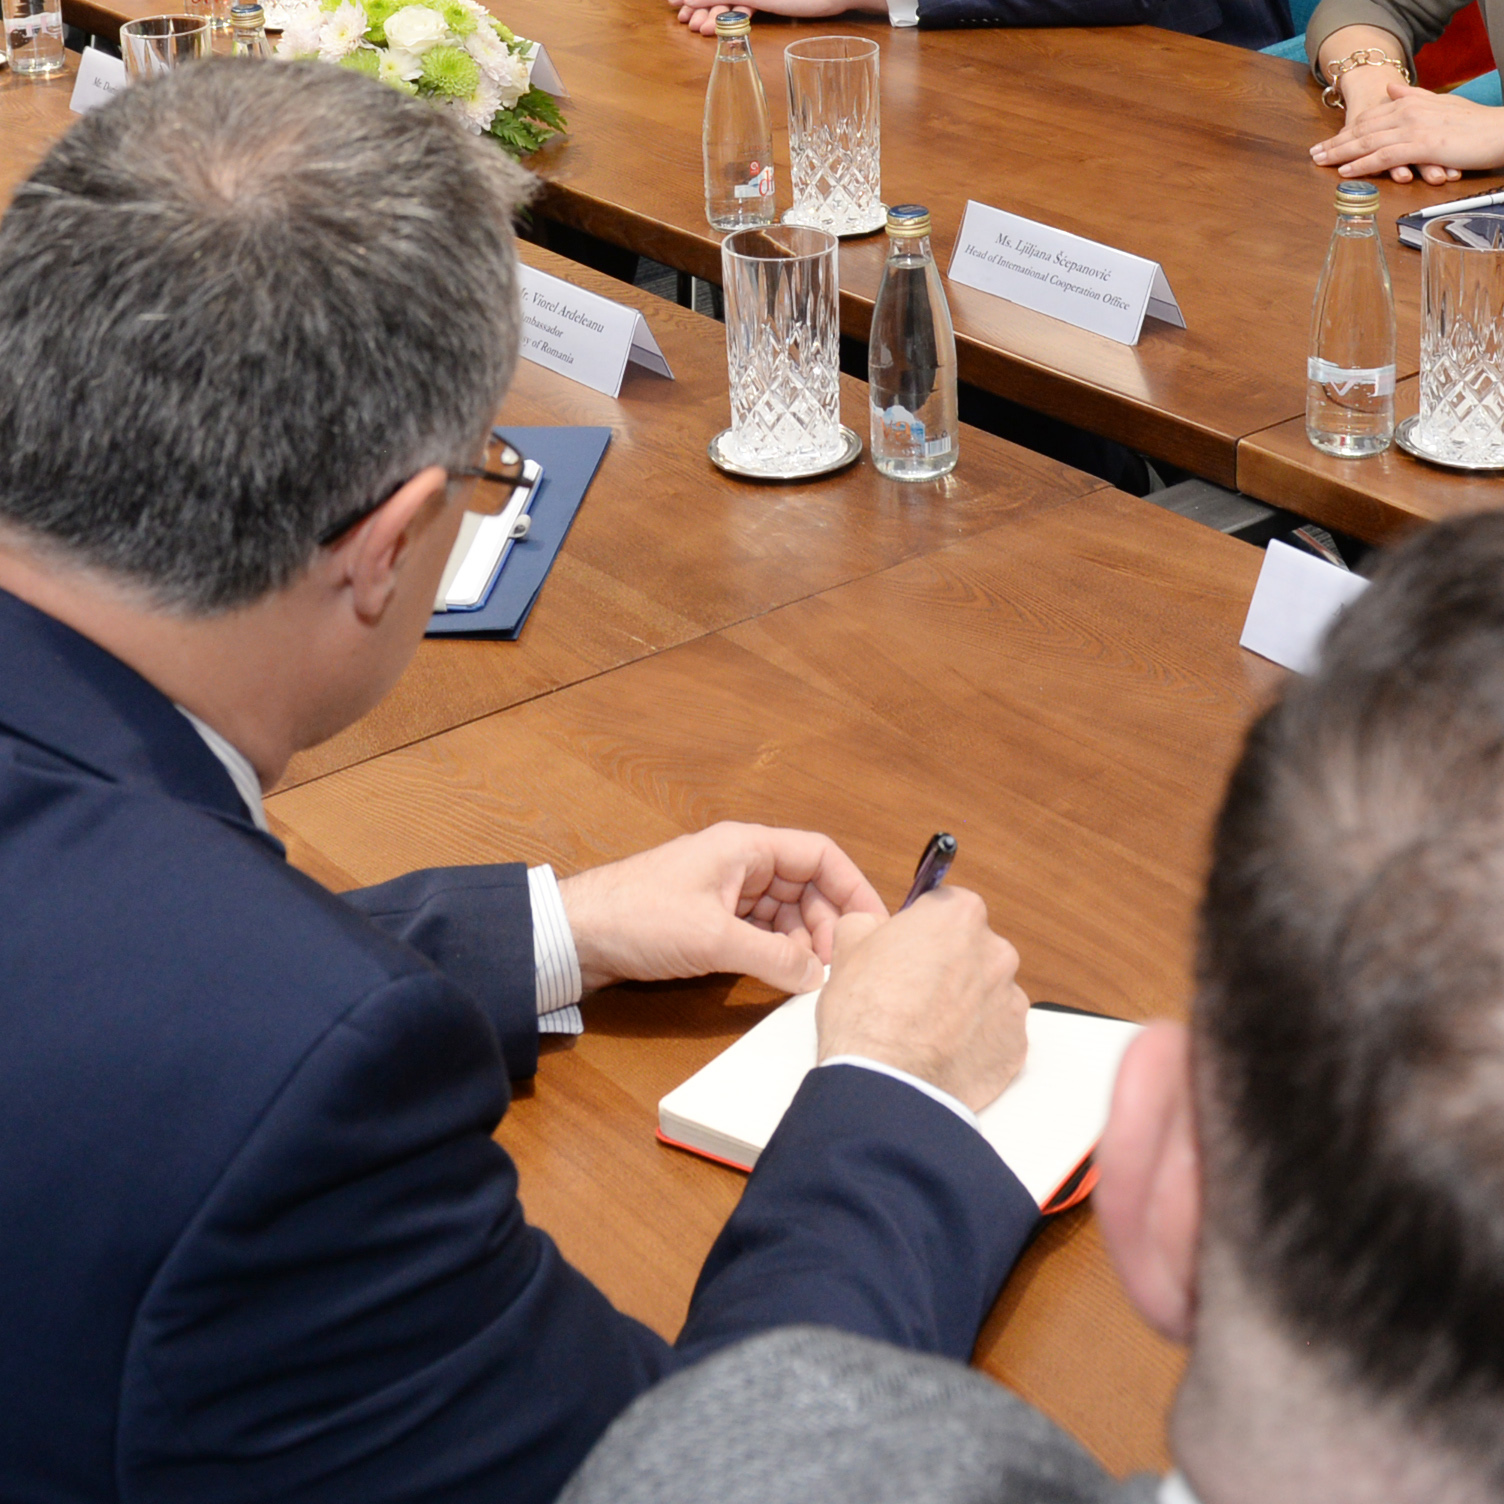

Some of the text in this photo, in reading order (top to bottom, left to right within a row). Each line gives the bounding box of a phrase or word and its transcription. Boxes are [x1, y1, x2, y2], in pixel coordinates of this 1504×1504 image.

[964, 244, 1131, 311] Head of International Cooperation Office
[995, 233, 1112, 282] Ms. Ljiljana Šćepanović
[532, 292, 560, 313] Viorel
[557, 305, 605, 333] Ardeleanu
[531, 339, 543, 349] of
[541, 341, 575, 365] Romania
